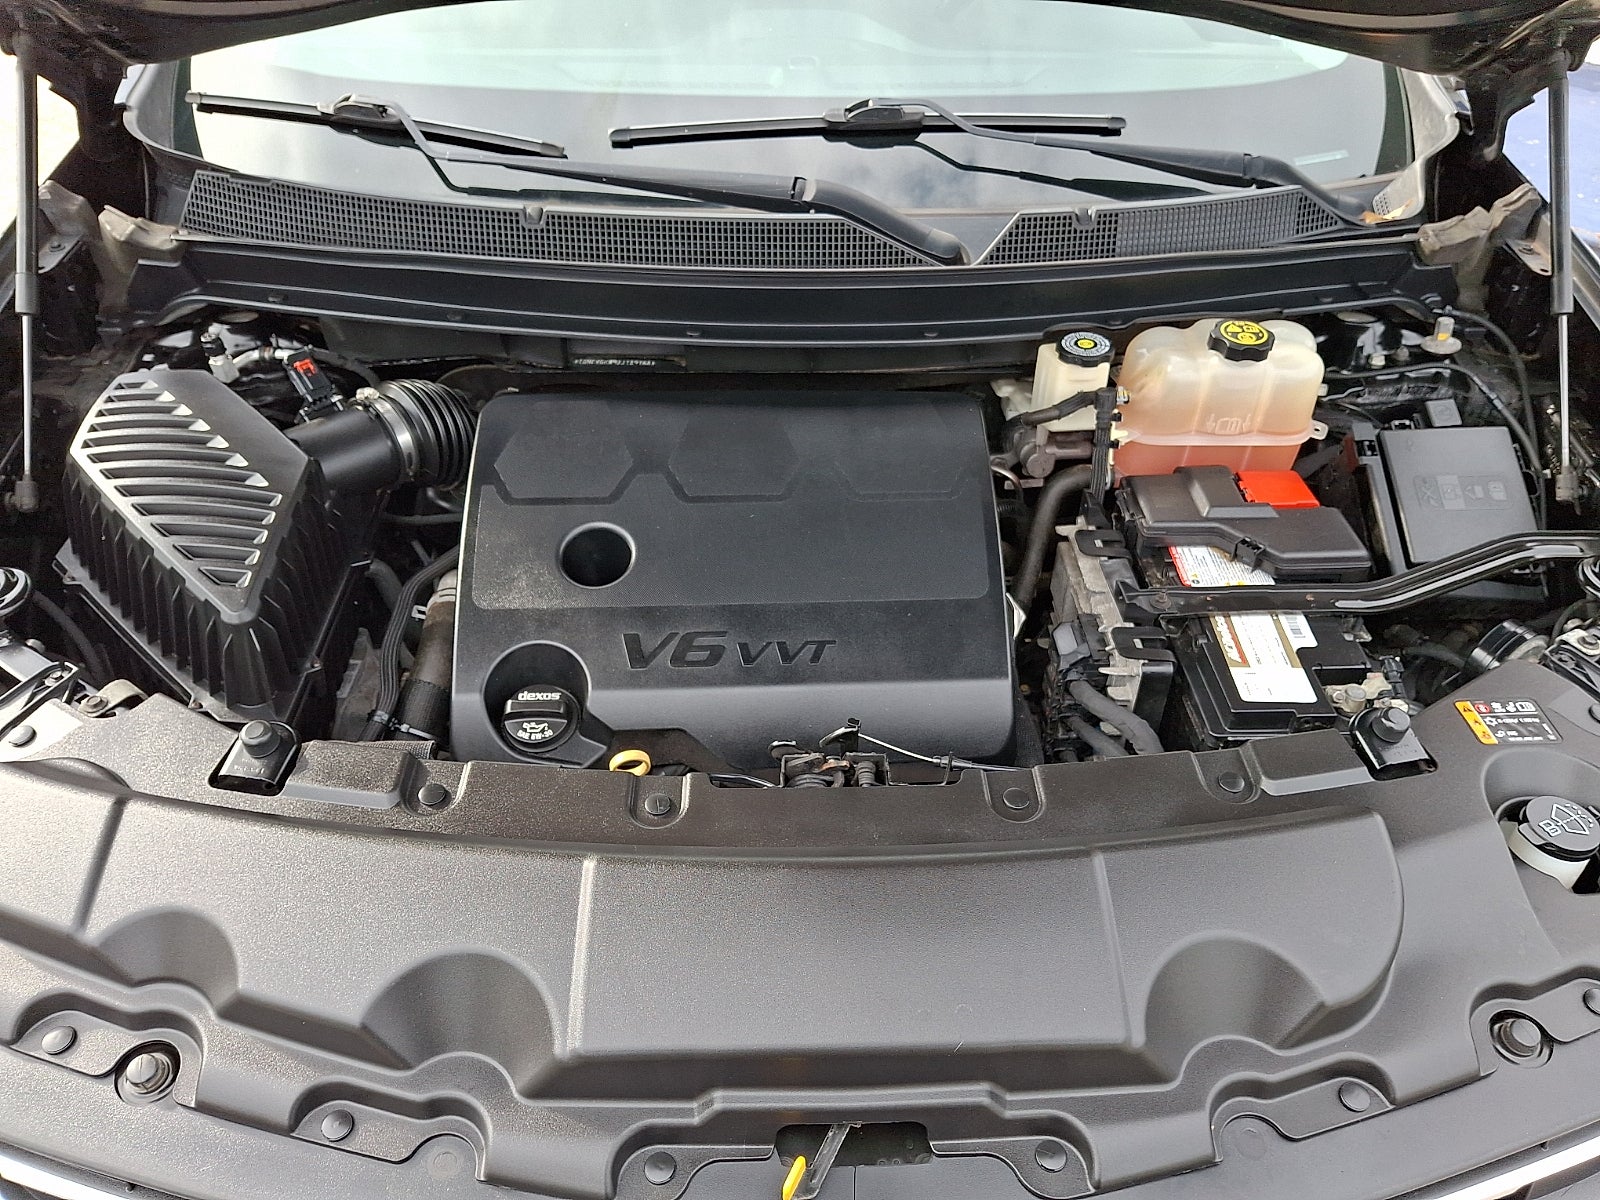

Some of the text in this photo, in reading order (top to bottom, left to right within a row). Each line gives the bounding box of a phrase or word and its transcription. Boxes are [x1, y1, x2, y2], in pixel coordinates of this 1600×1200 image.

[622, 631, 837, 670] V6 VVT
[518, 690, 562, 701] dexos
[517, 729, 531, 740] SAE
